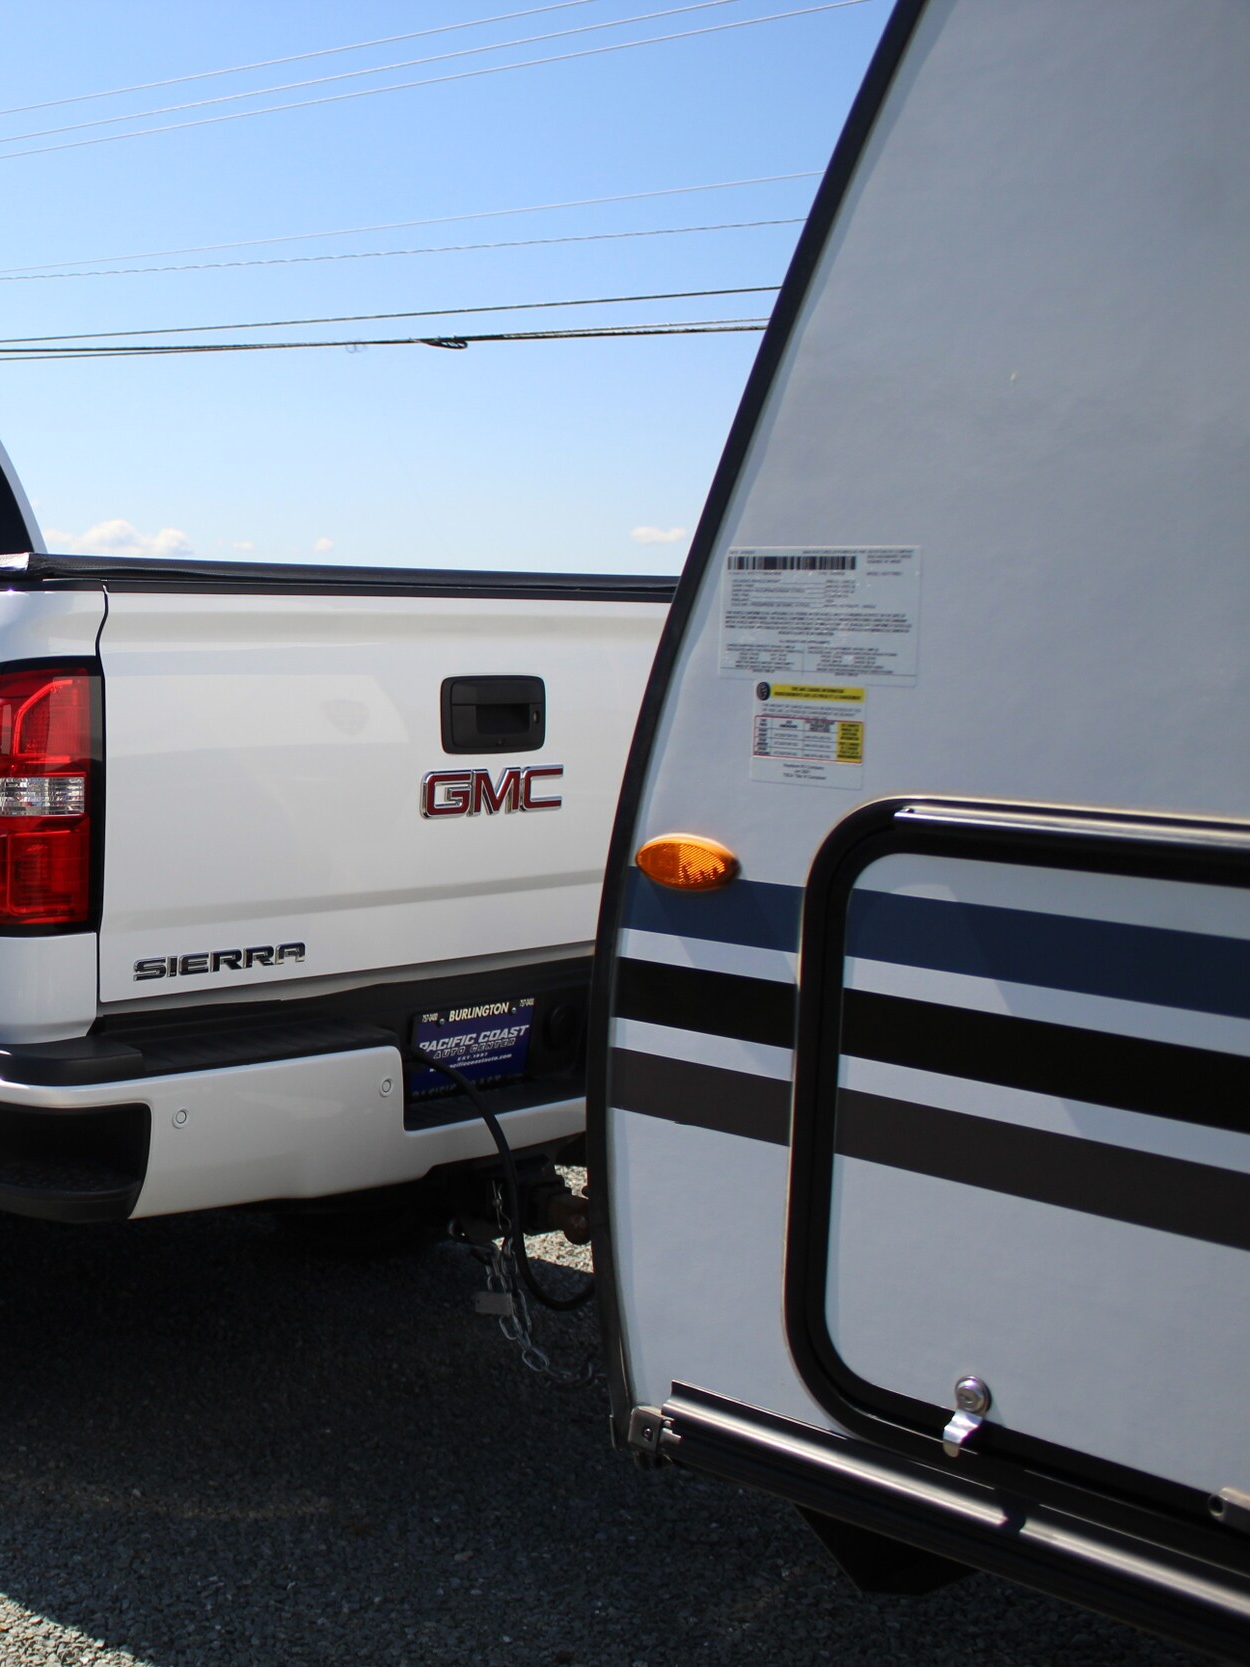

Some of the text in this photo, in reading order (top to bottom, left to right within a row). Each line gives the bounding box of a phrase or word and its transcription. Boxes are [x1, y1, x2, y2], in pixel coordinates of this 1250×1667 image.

[420, 764, 564, 819] GMC
[133, 941, 306, 981] SIERRA
[448, 1002, 510, 1022] BURLINGTON
[419, 1025, 530, 1053] PACIFIC COAST
[433, 1037, 516, 1059] AUTO CENTER
